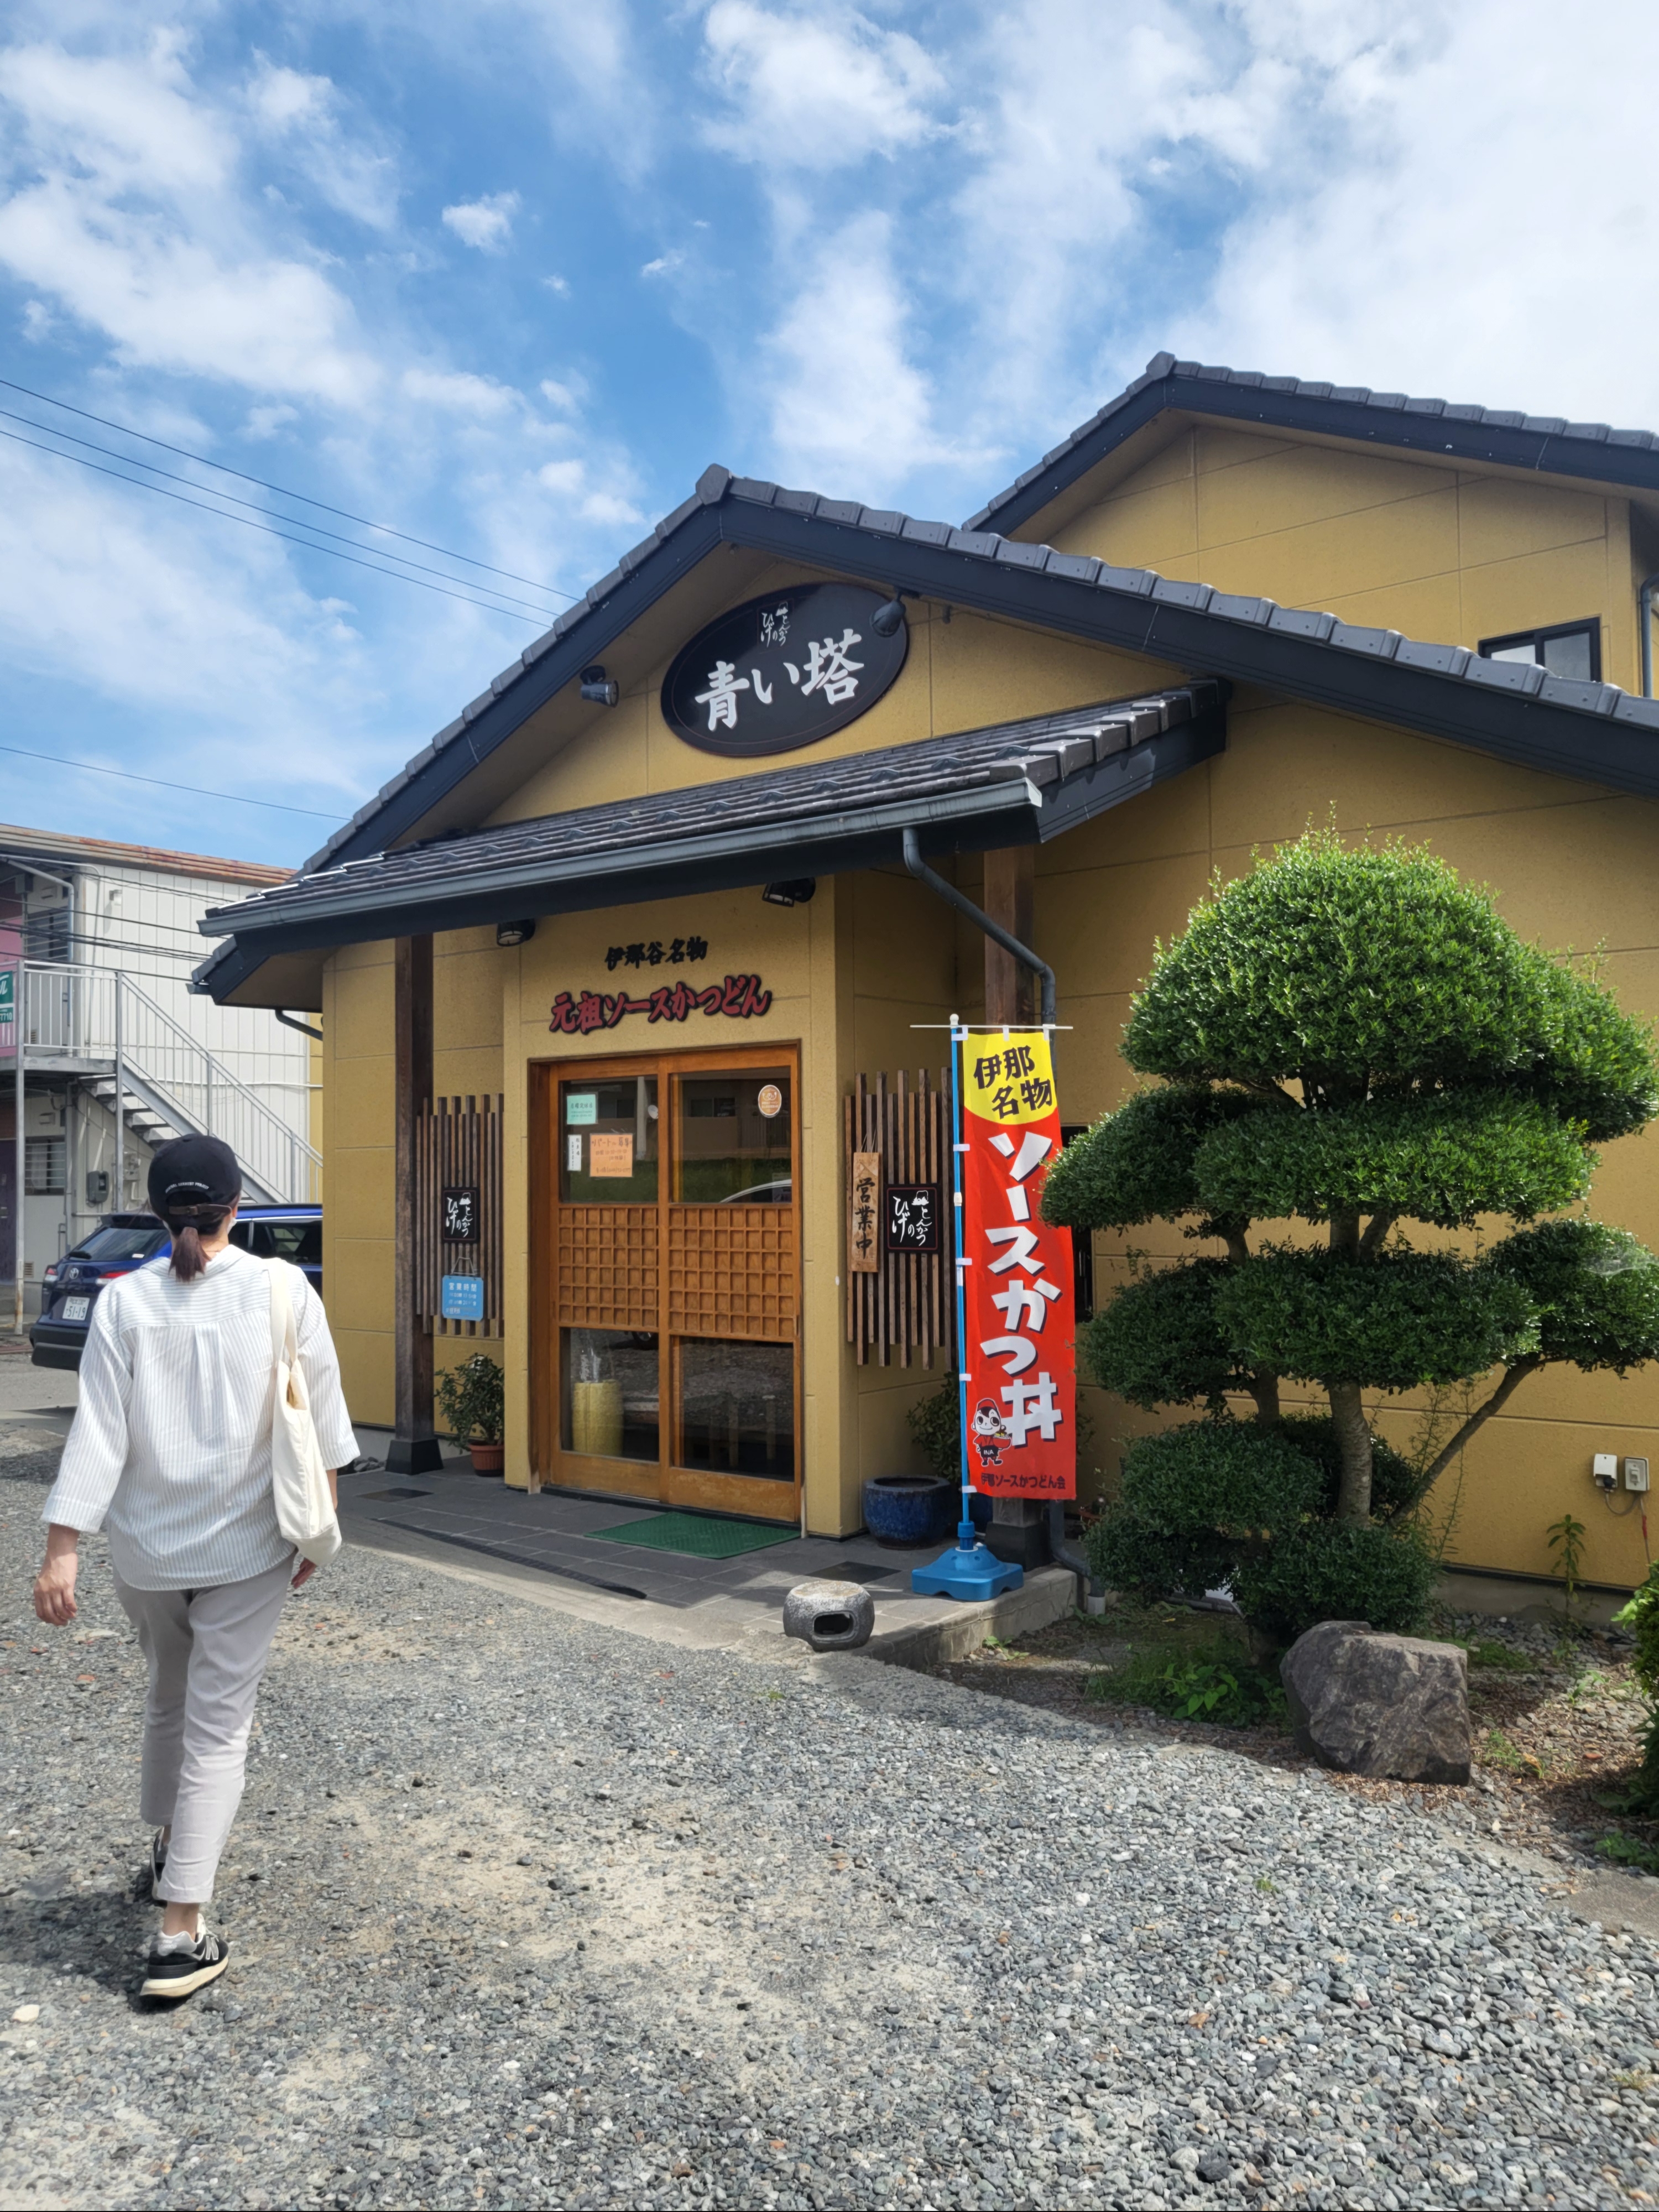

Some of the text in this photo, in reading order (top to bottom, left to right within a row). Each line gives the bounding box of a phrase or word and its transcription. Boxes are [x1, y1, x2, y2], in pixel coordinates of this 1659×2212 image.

[695, 628, 864, 732] 青い塔
[605, 936, 708, 971] 伊那谷名物
[549, 974, 773, 1034] 元祖ソースかつどん
[973, 1045, 1035, 1089] 伊那
[992, 1077, 1052, 1119] 名物
[854, 1177, 875, 1260] 営業中
[980, 1131, 1063, 1448] ソースかつ丼
